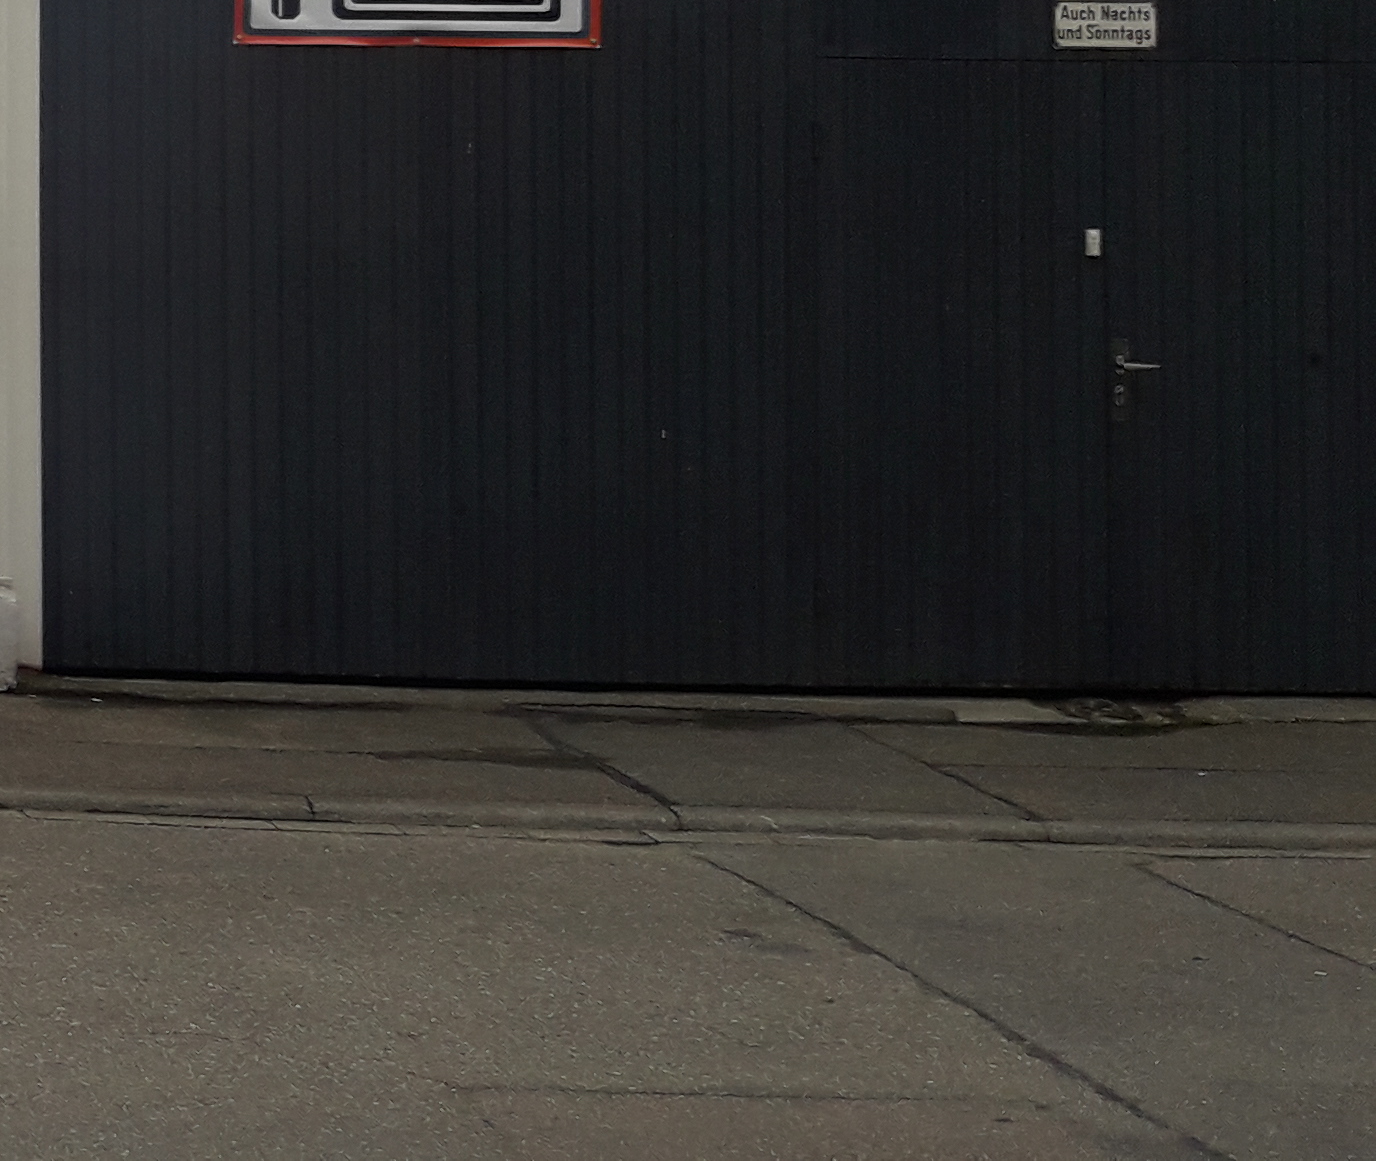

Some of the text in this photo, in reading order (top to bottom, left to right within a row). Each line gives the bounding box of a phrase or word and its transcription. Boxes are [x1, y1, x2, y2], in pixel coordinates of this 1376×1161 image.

[1060, 5, 1150, 22] Auch Nachts
[1057, 24, 1151, 44] und Sonntags
